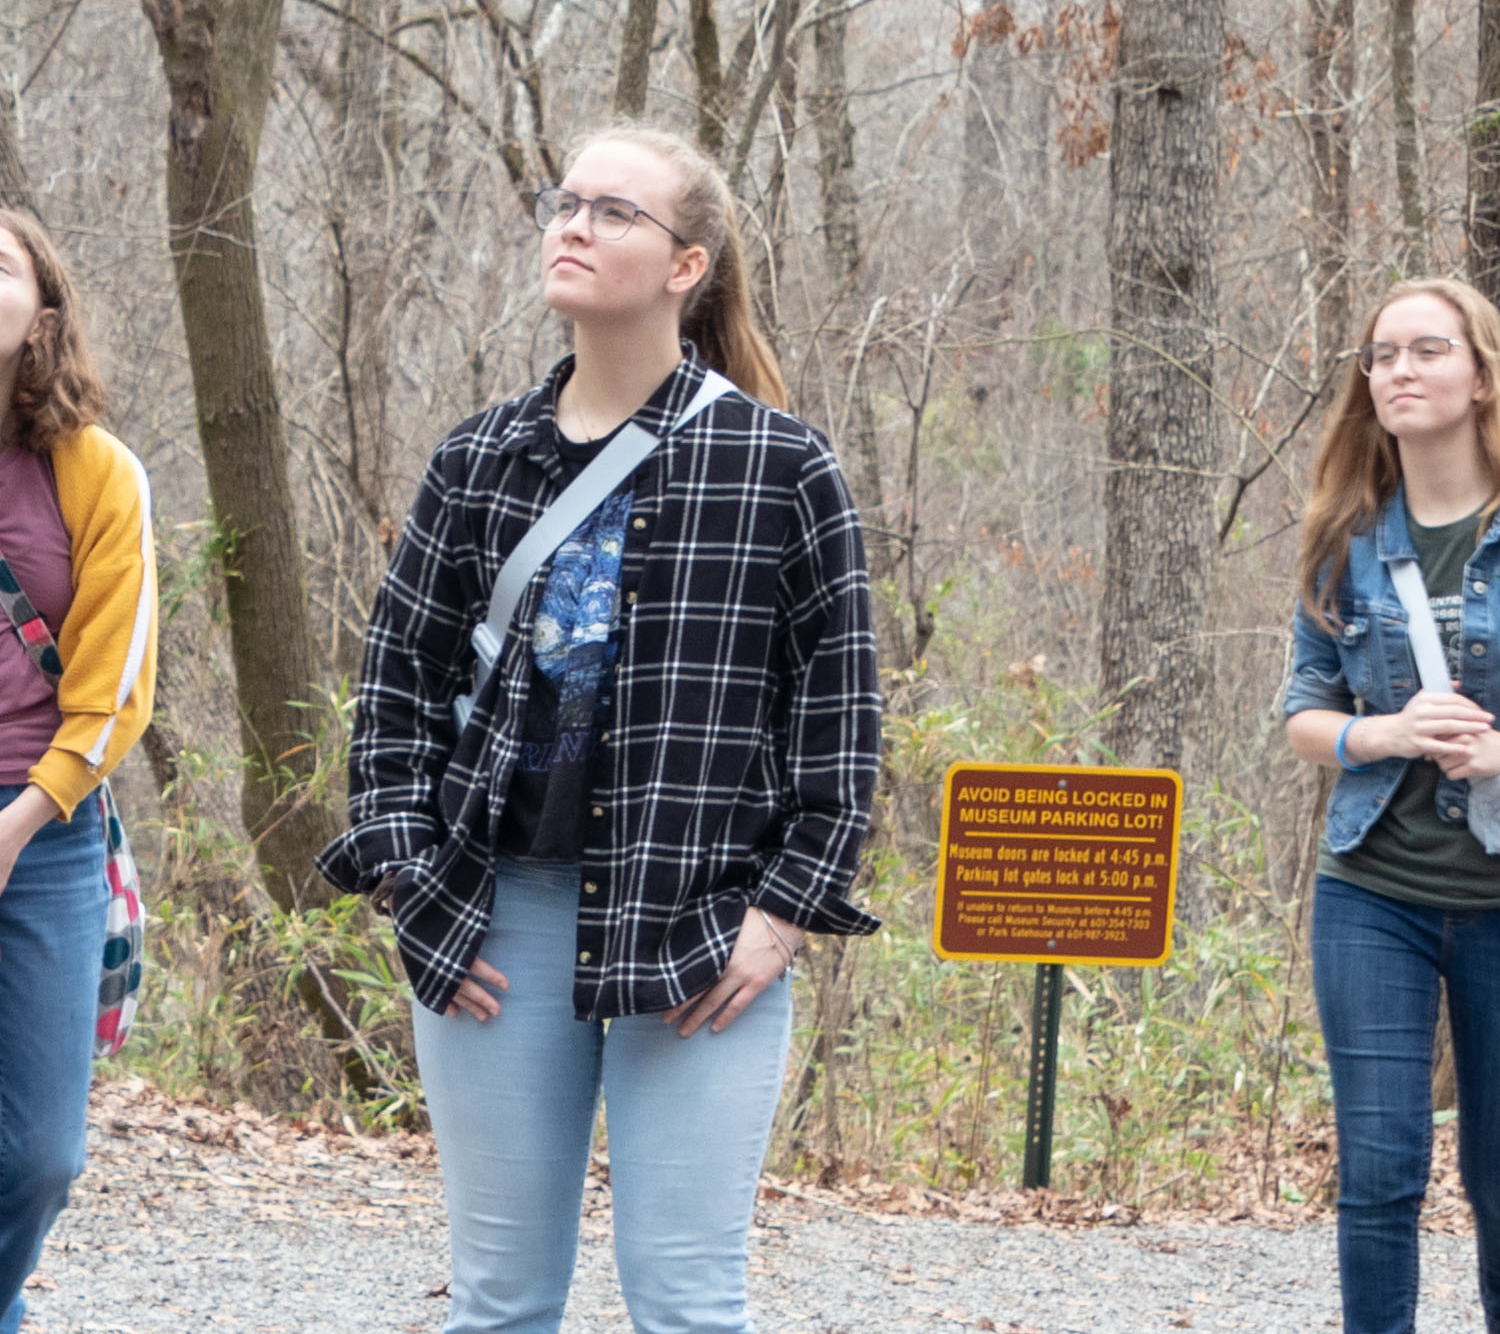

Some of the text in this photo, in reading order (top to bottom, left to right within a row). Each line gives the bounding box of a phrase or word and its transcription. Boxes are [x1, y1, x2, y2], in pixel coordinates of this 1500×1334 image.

[957, 787, 1168, 809] AVOID BEING LOCKED IN
[960, 808, 1163, 830] MUSEUM PARKING LOT!
[949, 843, 1168, 869] Museum doors are locked at 4:45 p.m.
[956, 865, 1158, 890] Parking lot gates lock at 5:00 p.m.
[1036, 903, 1045, 914] to
[1047, 904, 1082, 915] Museum
[958, 913, 985, 924] Please
[1005, 915, 1039, 926] Museum
[1042, 915, 1077, 928] Security
[988, 926, 1008, 938] Park
